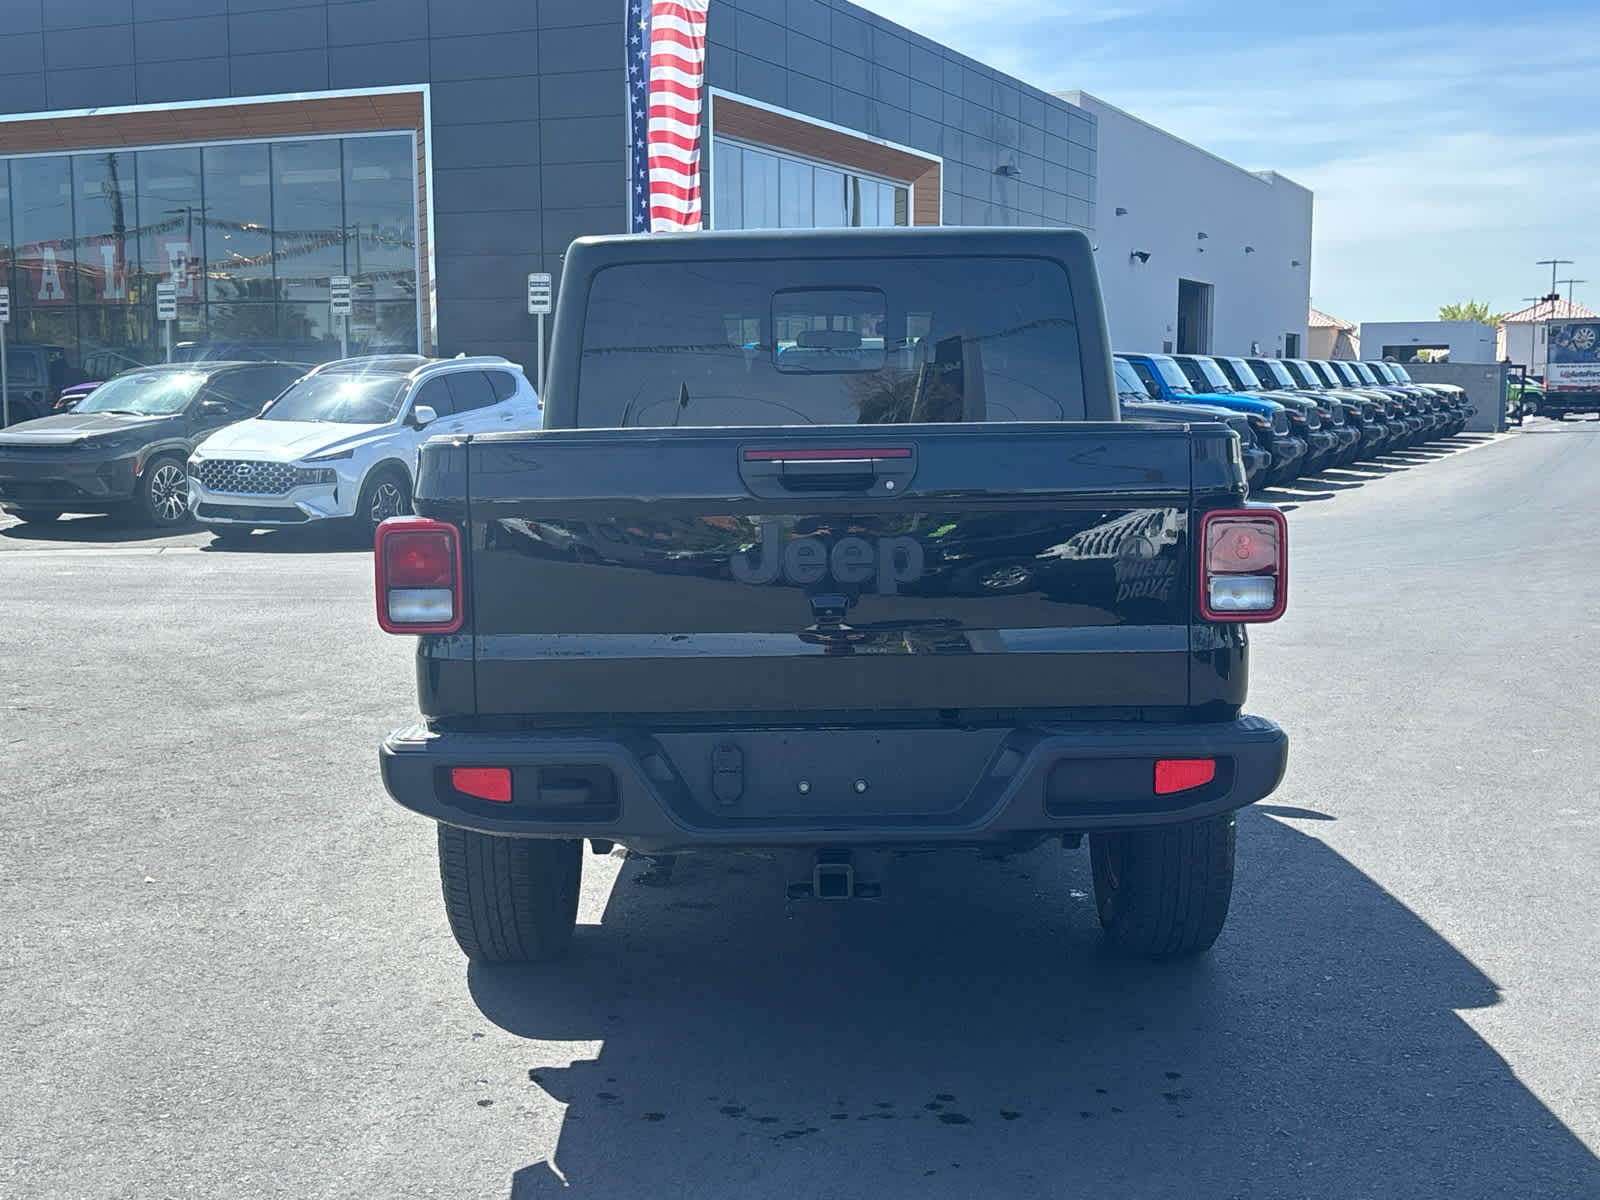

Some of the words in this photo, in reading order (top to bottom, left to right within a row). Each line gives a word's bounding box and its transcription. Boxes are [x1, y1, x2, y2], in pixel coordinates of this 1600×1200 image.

[730, 519, 924, 595] Jeep
[1113, 559, 1176, 584] WHEEL
[1116, 577, 1174, 603] DRIVE
